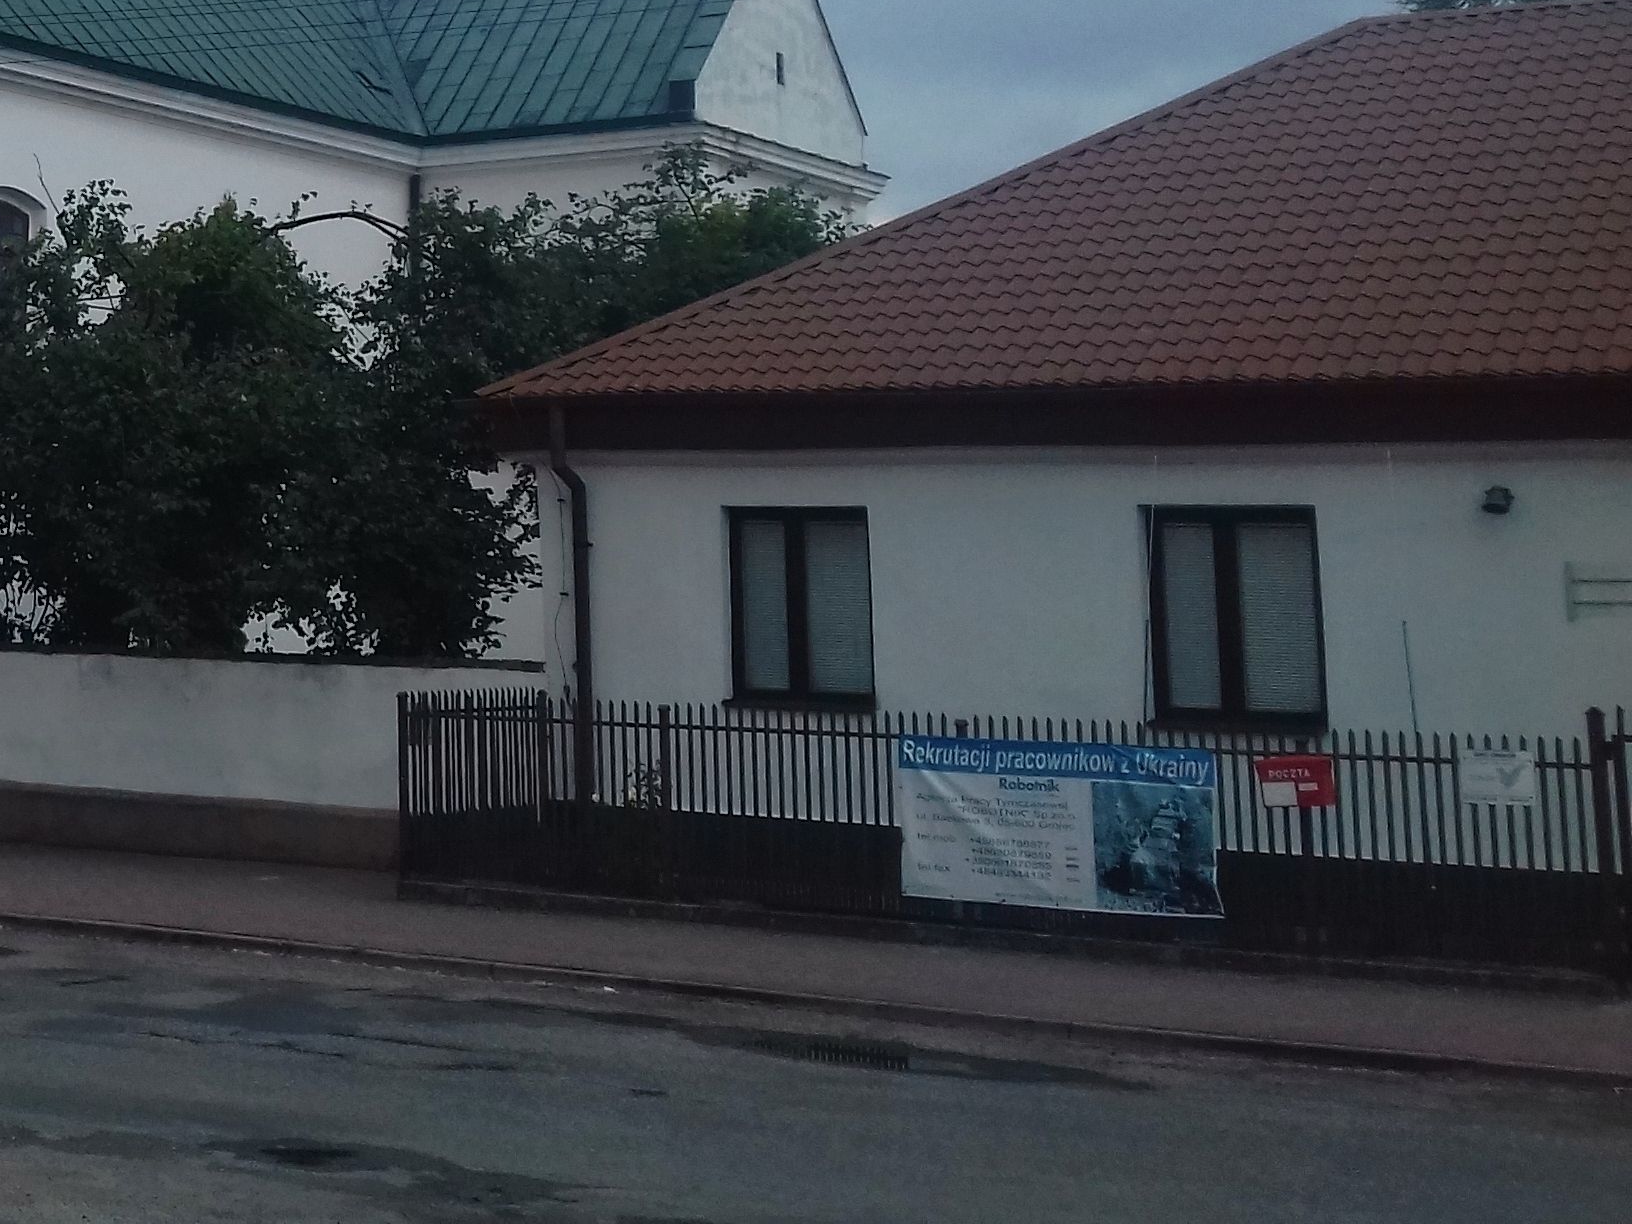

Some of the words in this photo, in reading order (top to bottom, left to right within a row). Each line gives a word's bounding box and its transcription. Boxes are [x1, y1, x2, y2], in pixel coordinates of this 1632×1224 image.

[902, 739, 990, 772] Rekrutacji
[1120, 755, 1130, 774] z
[1136, 751, 1210, 786] Ukrainy
[1268, 768, 1311, 779] POCZTA
[999, 778, 1060, 793] Robotnik
